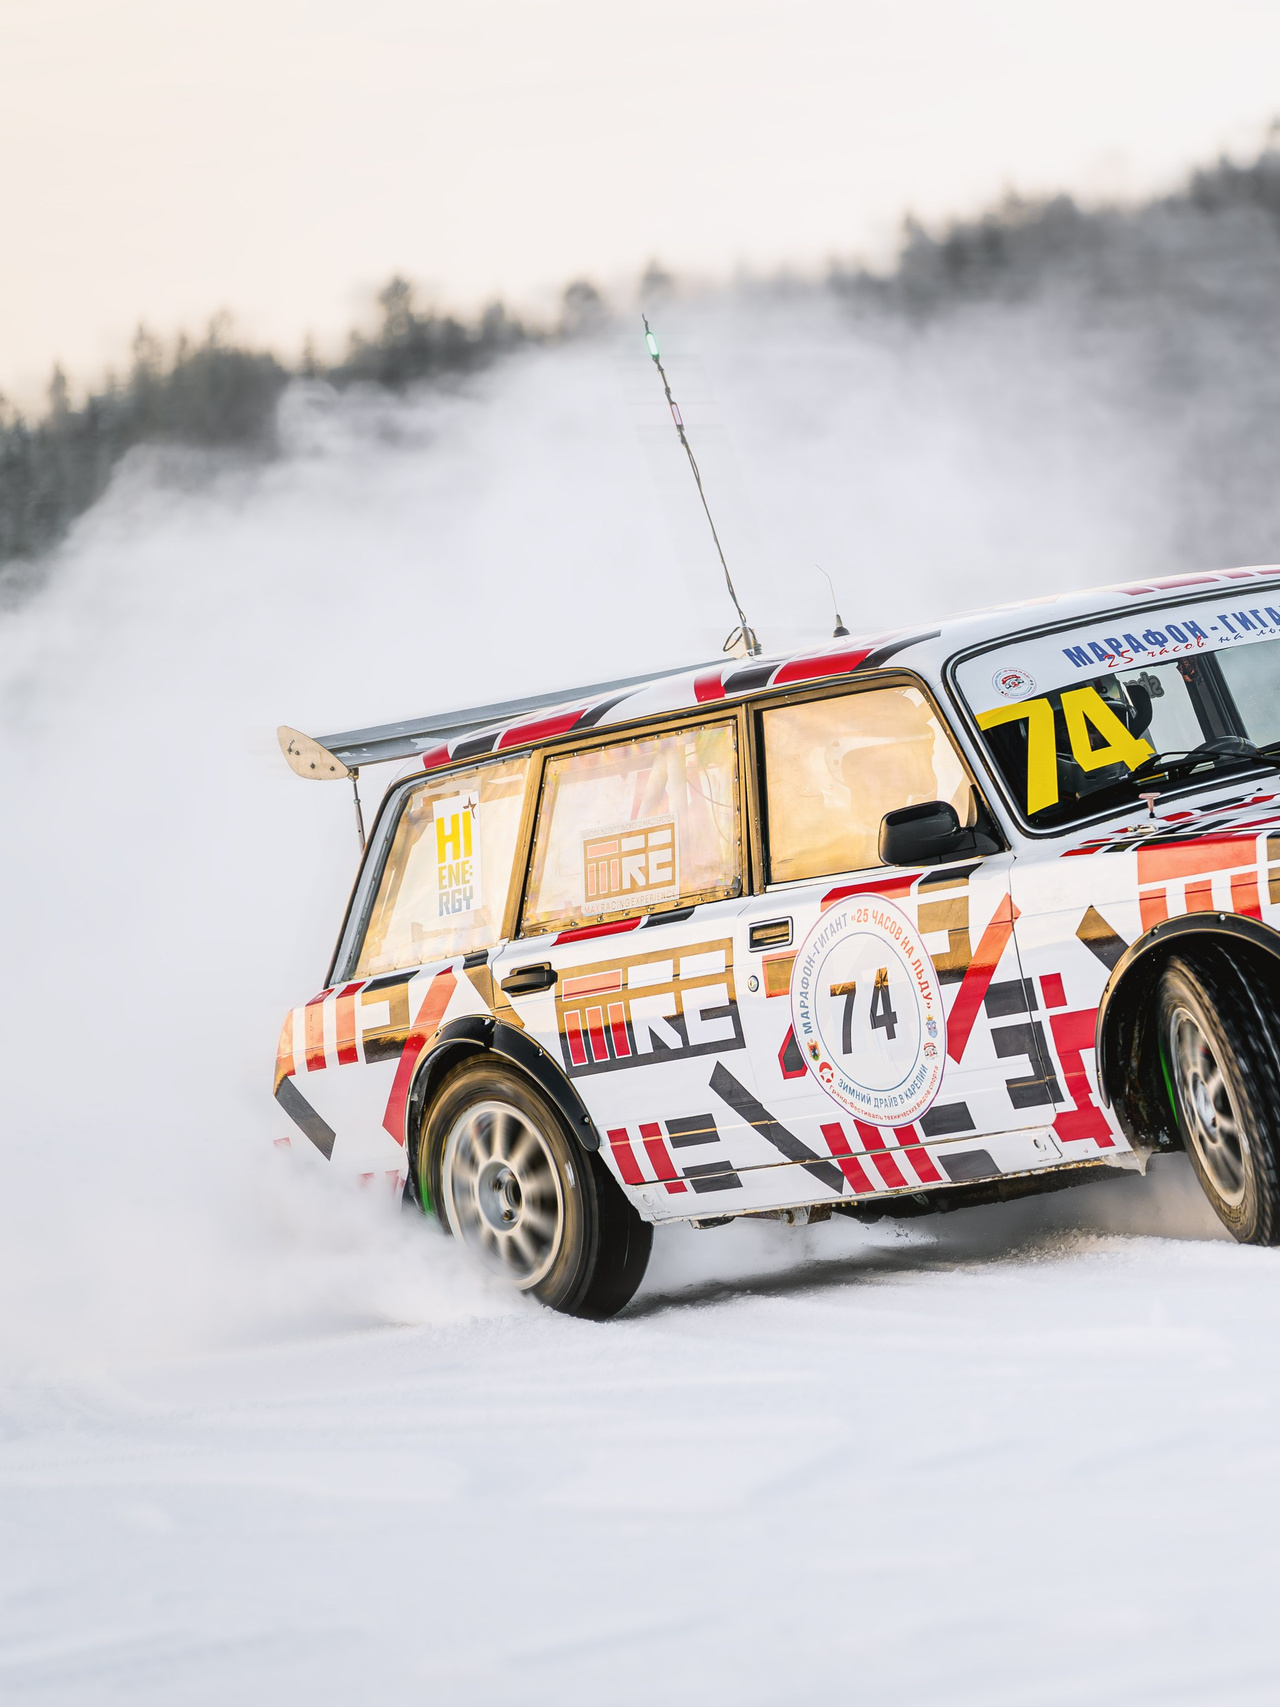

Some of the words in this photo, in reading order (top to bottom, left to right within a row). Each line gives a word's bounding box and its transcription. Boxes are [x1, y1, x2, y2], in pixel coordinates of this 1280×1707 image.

[1103, 649, 1134, 668] 25
[975, 687, 1156, 816] 74
[435, 810, 473, 864] HI
[439, 885, 474, 917] RGY
[800, 913, 848, 1034] МАРАФОН-ГИГАНТ
[872, 909, 903, 940] ЧАСОВ
[900, 936, 915, 959] НА
[829, 967, 898, 1055] 74
[838, 1078, 871, 1106] ЗИМНИЙ
[873, 1095, 899, 1109] ДРАЙВ
[899, 1094, 905, 1104] В
[904, 1063, 928, 1098] КАРЕЛИИ
